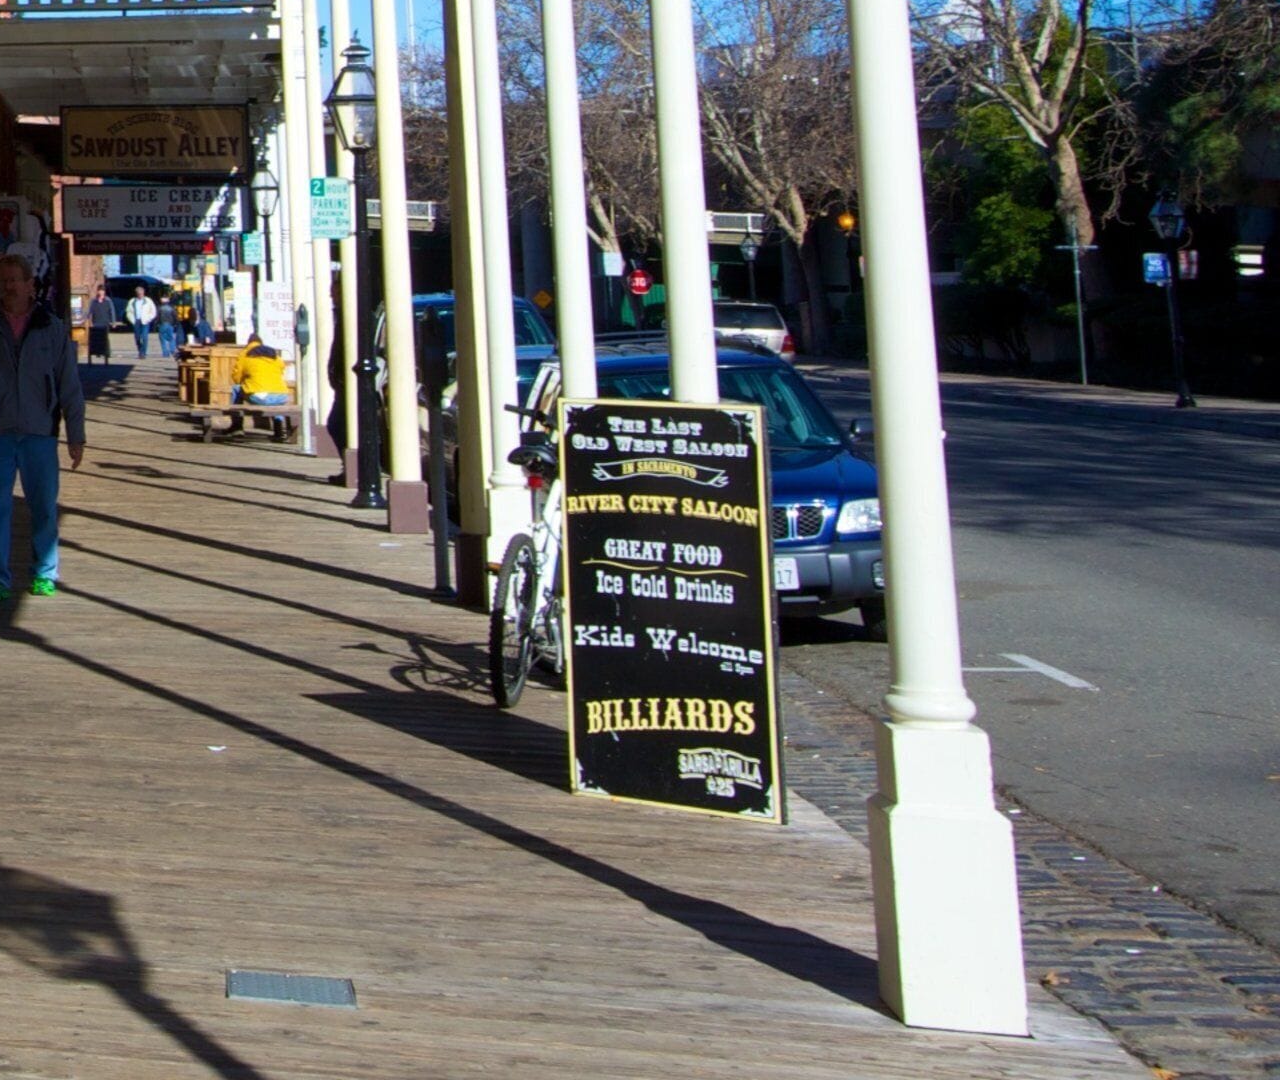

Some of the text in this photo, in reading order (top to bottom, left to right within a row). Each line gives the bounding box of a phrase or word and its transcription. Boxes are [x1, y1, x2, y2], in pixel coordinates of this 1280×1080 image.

[70, 133, 240, 158] SAWDUST ALLEY
[130, 188, 159, 202] ICE
[313, 180, 321, 194] 2
[76, 198, 111, 209] SAM'S
[80, 209, 108, 218] CAFE
[168, 204, 193, 213] AND
[312, 198, 348, 209] PARKING
[123, 215, 237, 229] SANDWICHES
[607, 416, 703, 436] THE LAST
[571, 433, 749, 458] OLD WEST SALOON
[637, 461, 698, 479] SACRAMENTO
[567, 495, 759, 528] RIVER CITY SALOON
[604, 538, 723, 566] GREAT FOOD
[596, 570, 735, 604] Ice Cold Drinks
[574, 625, 764, 665] Kids Welcome
[586, 697, 756, 735] BILLIARDS
[678, 752, 763, 783] SARSAPARILLA
